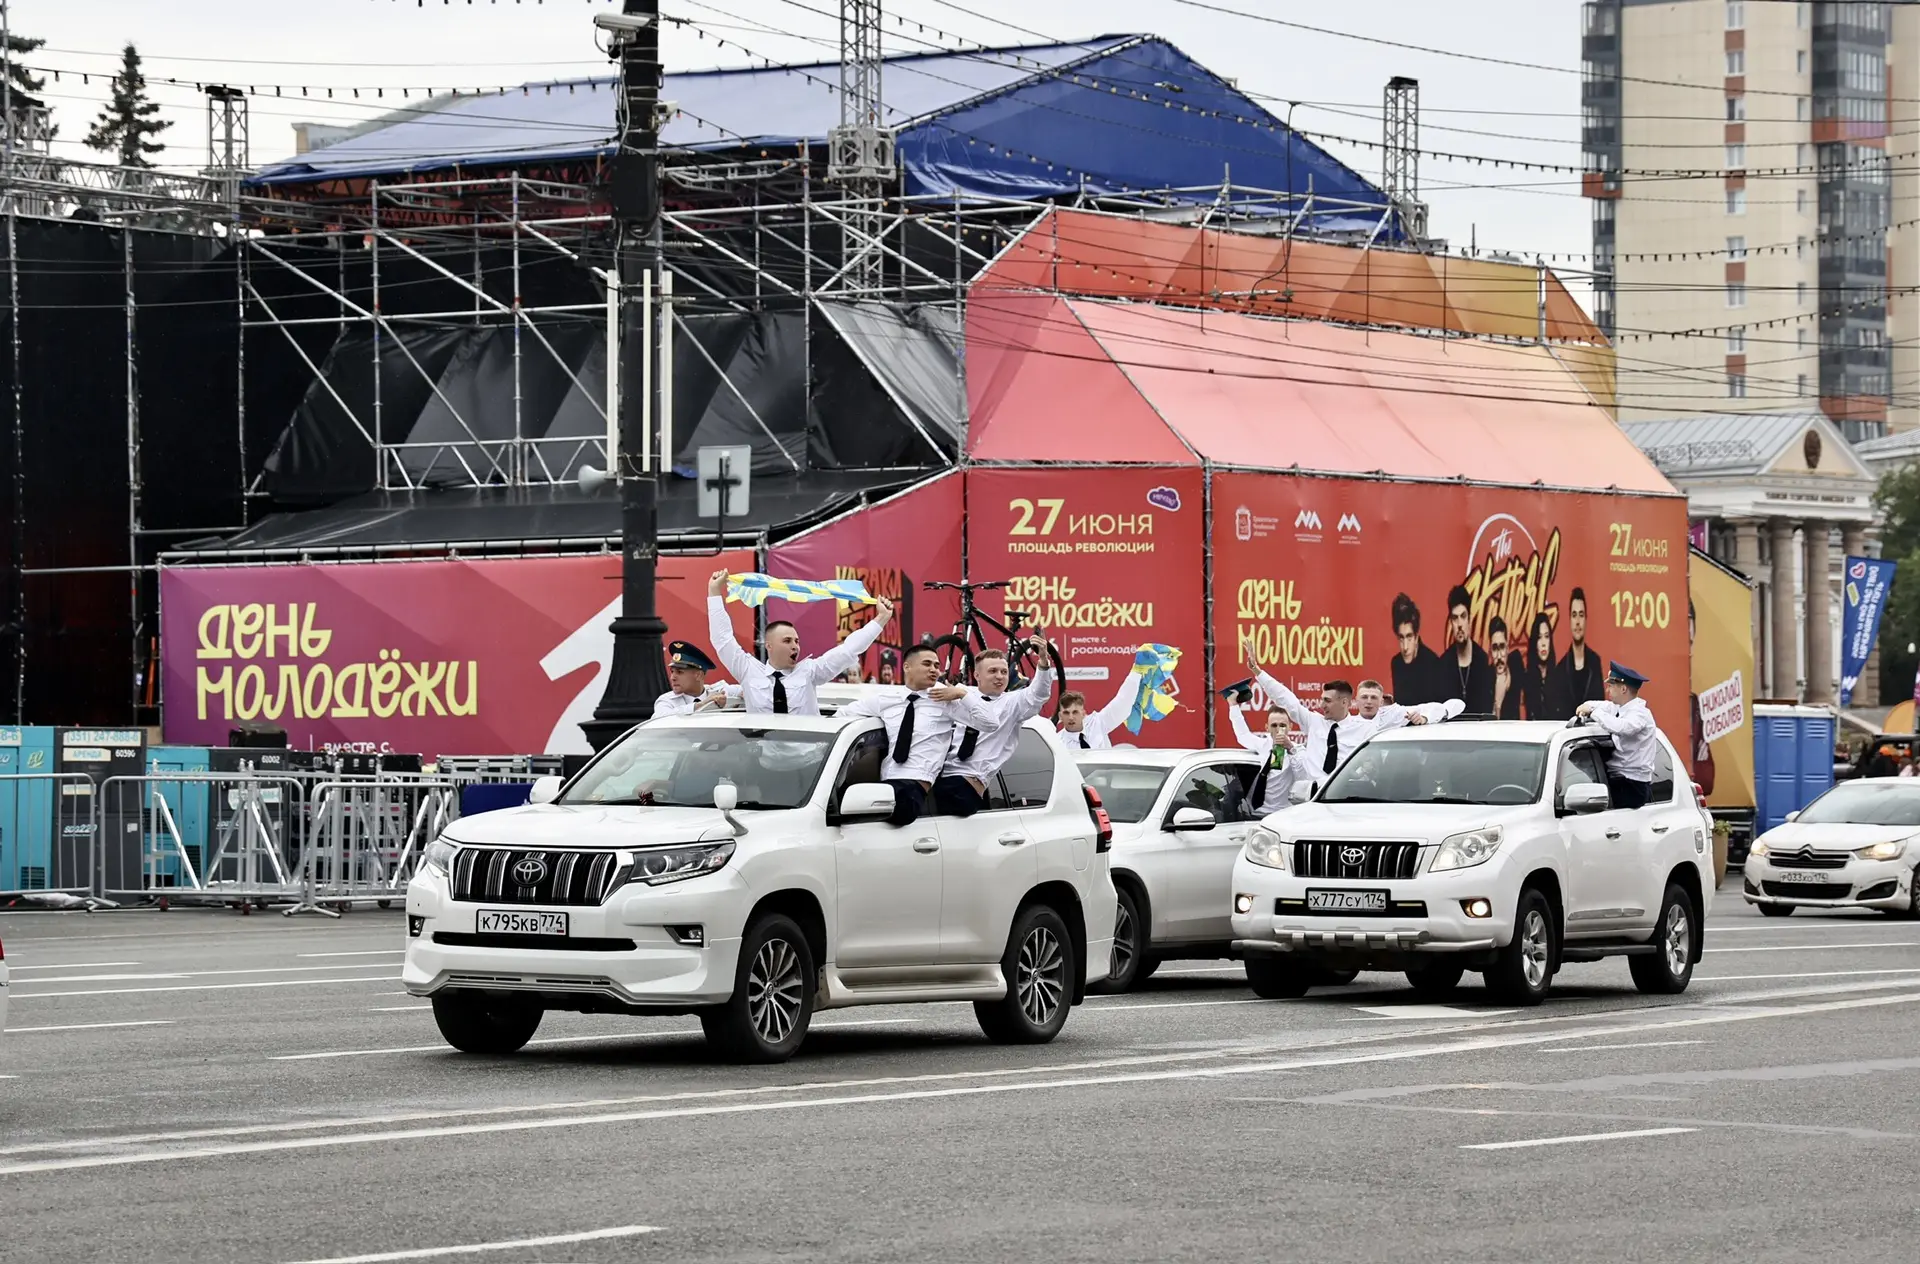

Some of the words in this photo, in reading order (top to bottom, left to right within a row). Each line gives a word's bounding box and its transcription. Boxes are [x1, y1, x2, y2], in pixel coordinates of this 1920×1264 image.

[1009, 498, 1065, 535] 27
[1069, 514, 1153, 535] ИЮНЯ
[1008, 543, 1073, 554] ПЛОЩАДЬ
[1075, 543, 1155, 554] РЕВОЛЮЦИИ
[1491, 528, 1514, 563] The
[1609, 523, 1632, 556] 27
[1633, 539, 1668, 557] ИЮНЯ
[1611, 591, 1670, 629] 12:00
[1071, 645, 1139, 658] росмолодё
[1702, 676, 1741, 716] НИКОЛАЙ
[1312, 893, 1362, 907] Х777СУ
[1364, 893, 1384, 904] 174
[482, 913, 539, 932] К795КВ
[540, 914, 563, 928] 774
